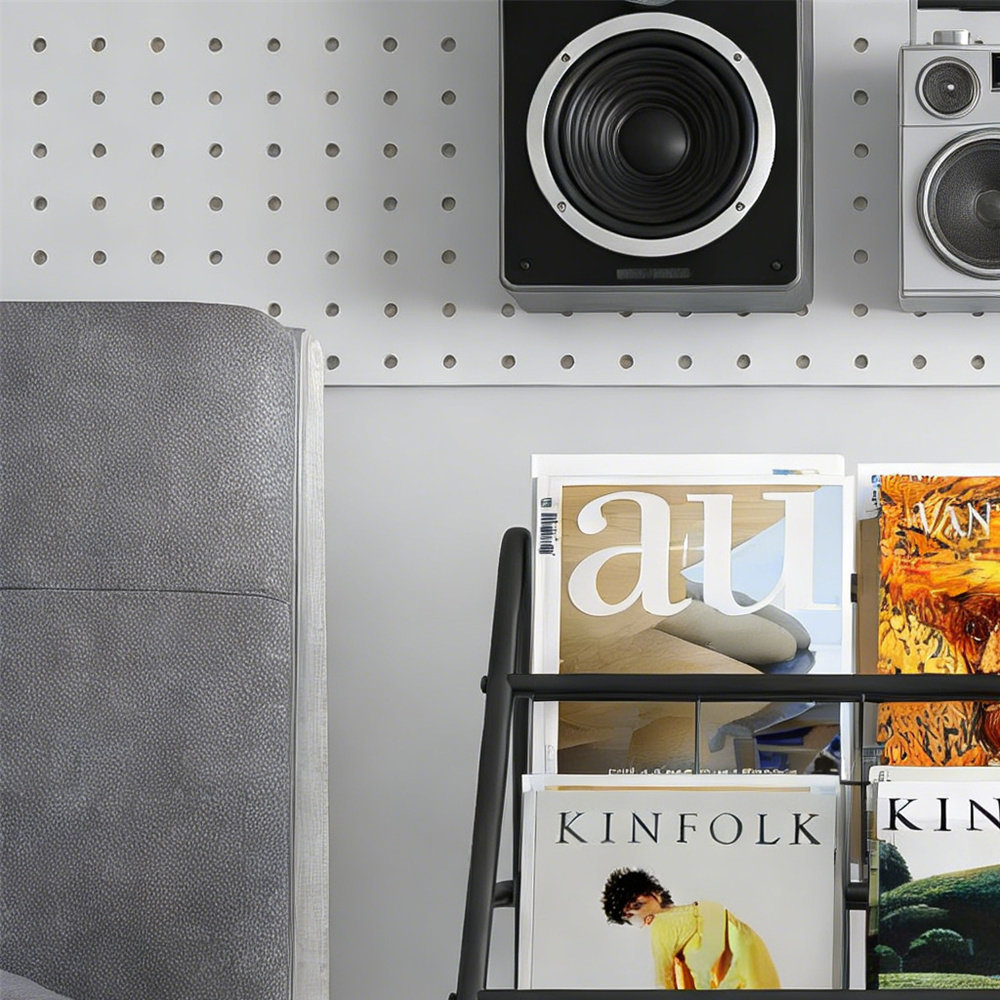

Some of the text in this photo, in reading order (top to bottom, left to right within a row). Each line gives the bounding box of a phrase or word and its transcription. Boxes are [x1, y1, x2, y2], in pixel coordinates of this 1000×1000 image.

[913, 501, 991, 540] VAN
[567, 490, 838, 618] au
[555, 811, 822, 847] KINFOLK
